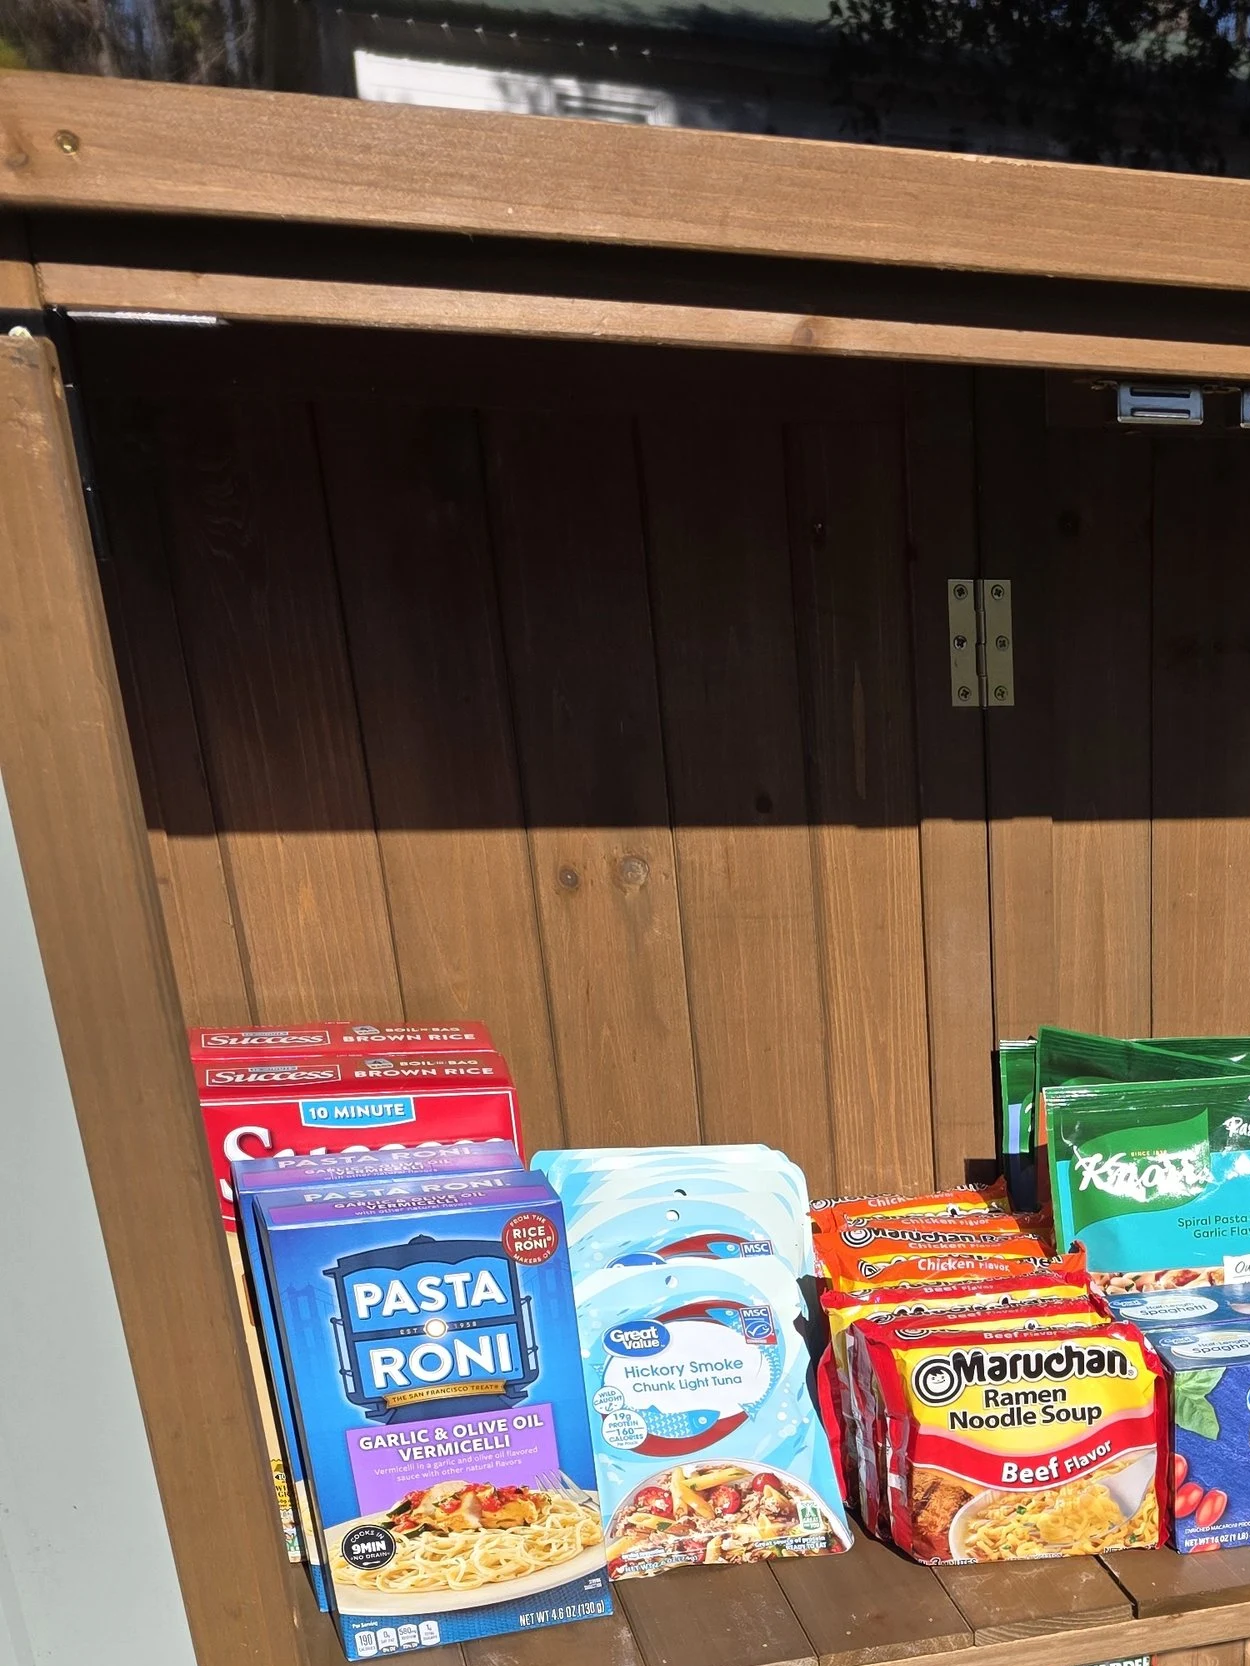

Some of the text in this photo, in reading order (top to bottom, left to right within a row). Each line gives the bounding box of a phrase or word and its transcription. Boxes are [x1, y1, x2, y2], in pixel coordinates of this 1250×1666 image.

[212, 1070, 334, 1083] Success
[354, 1067, 494, 1078] BROWN RICE
[309, 1103, 405, 1120] 10 MINUTE
[304, 1179, 506, 1202] PASTA RONI
[1177, 1216, 1212, 1229] Spiral
[1214, 1213, 1247, 1225] Pasta
[512, 1226, 545, 1239] RICE
[1193, 1227, 1228, 1239] Garlic
[918, 1258, 975, 1272] Chicken
[353, 1271, 508, 1319] PASTA
[743, 1309, 768, 1317] MSC
[610, 1327, 659, 1343] Great
[623, 1339, 660, 1350] Value
[369, 1333, 513, 1389] RONI
[624, 1359, 743, 1379] Hickory Smoke
[953, 1344, 1128, 1386] Maruchan
[633, 1375, 742, 1393] Chunk Light Tuna
[594, 1395, 622, 1406] CAUGHT
[983, 1389, 1067, 1409] Ramen
[949, 1405, 1103, 1431] Noodle Soup
[359, 1415, 544, 1450] GARLIC & OLIVE OIL
[399, 1435, 511, 1462] VERMICELLI
[1002, 1439, 1112, 1484] Beef Flavor
[519, 1613, 535, 1627] NET
[536, 1610, 549, 1623] WT
[551, 1608, 564, 1621] 4.6
[566, 1606, 576, 1617] OZ
